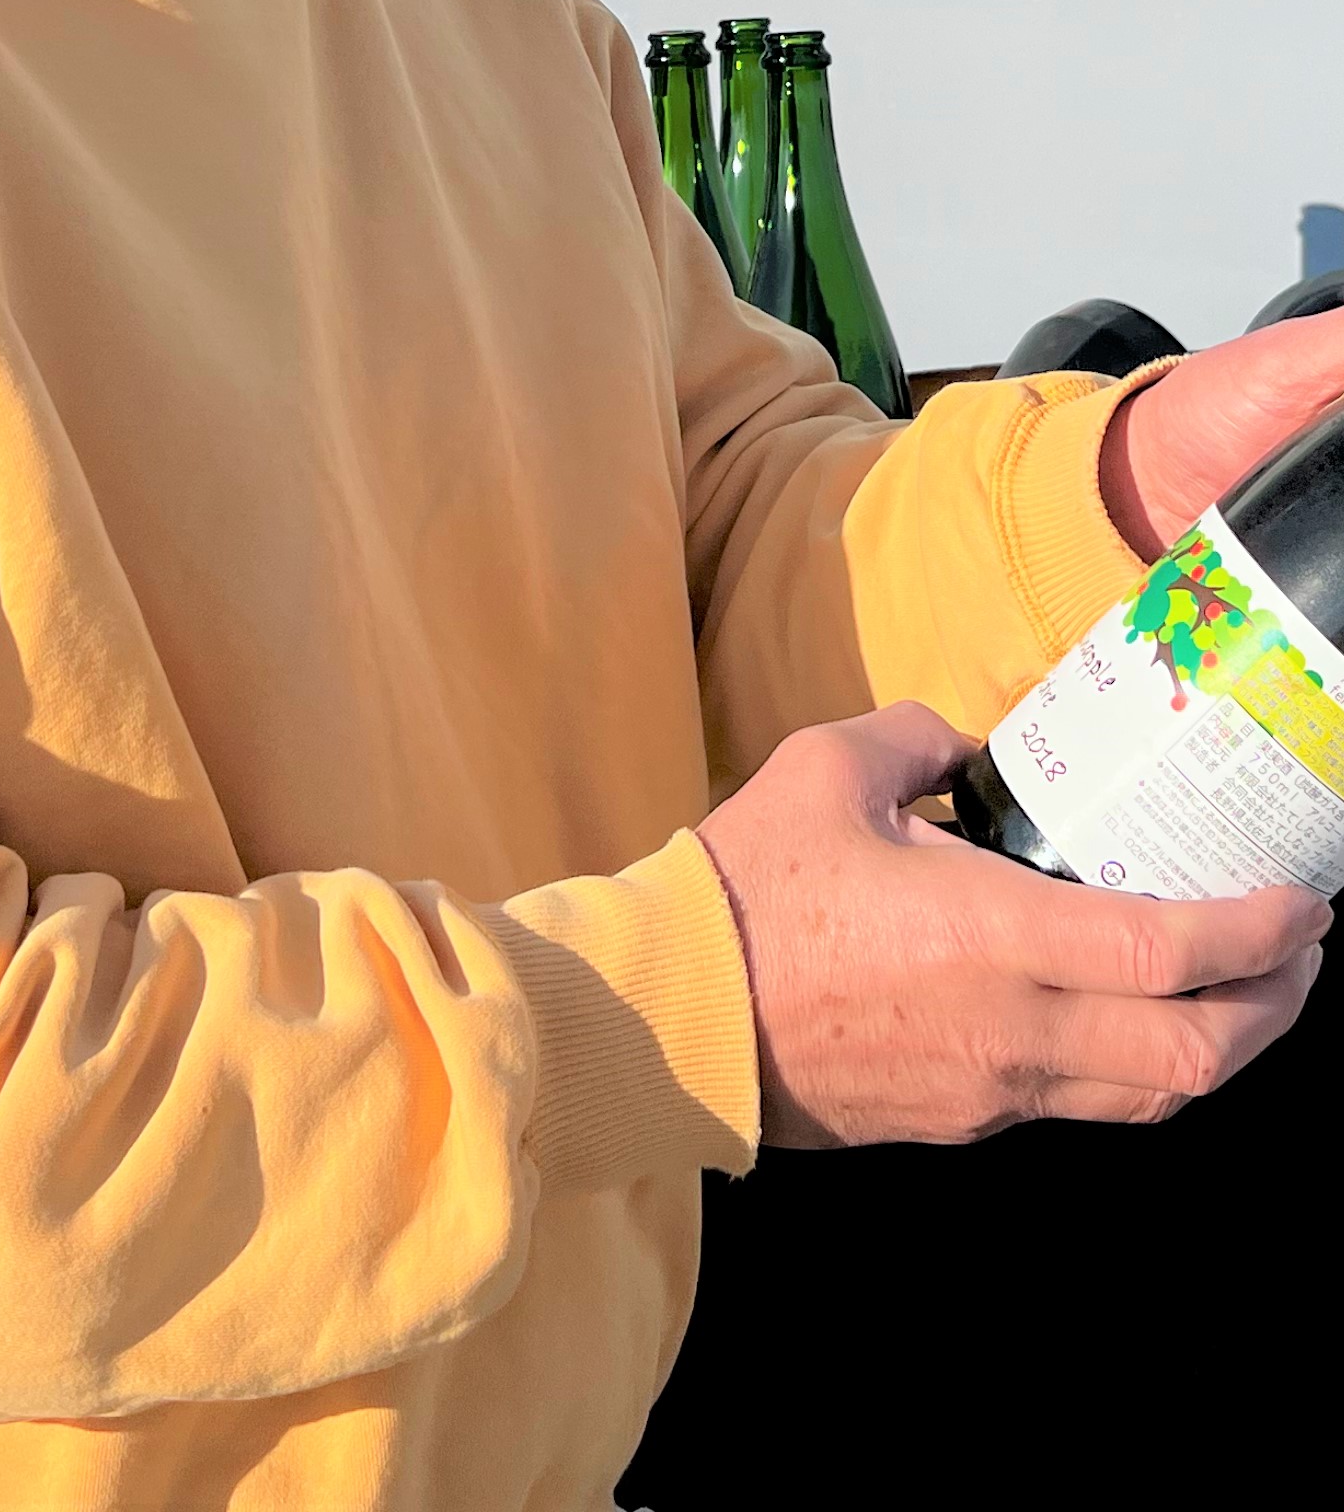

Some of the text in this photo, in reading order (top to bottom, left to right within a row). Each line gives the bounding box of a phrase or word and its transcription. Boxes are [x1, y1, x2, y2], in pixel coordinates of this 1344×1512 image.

[1194, 722, 1233, 763] 販売元
[1207, 711, 1245, 750] 内容量
[1020, 722, 1068, 784] 2018
